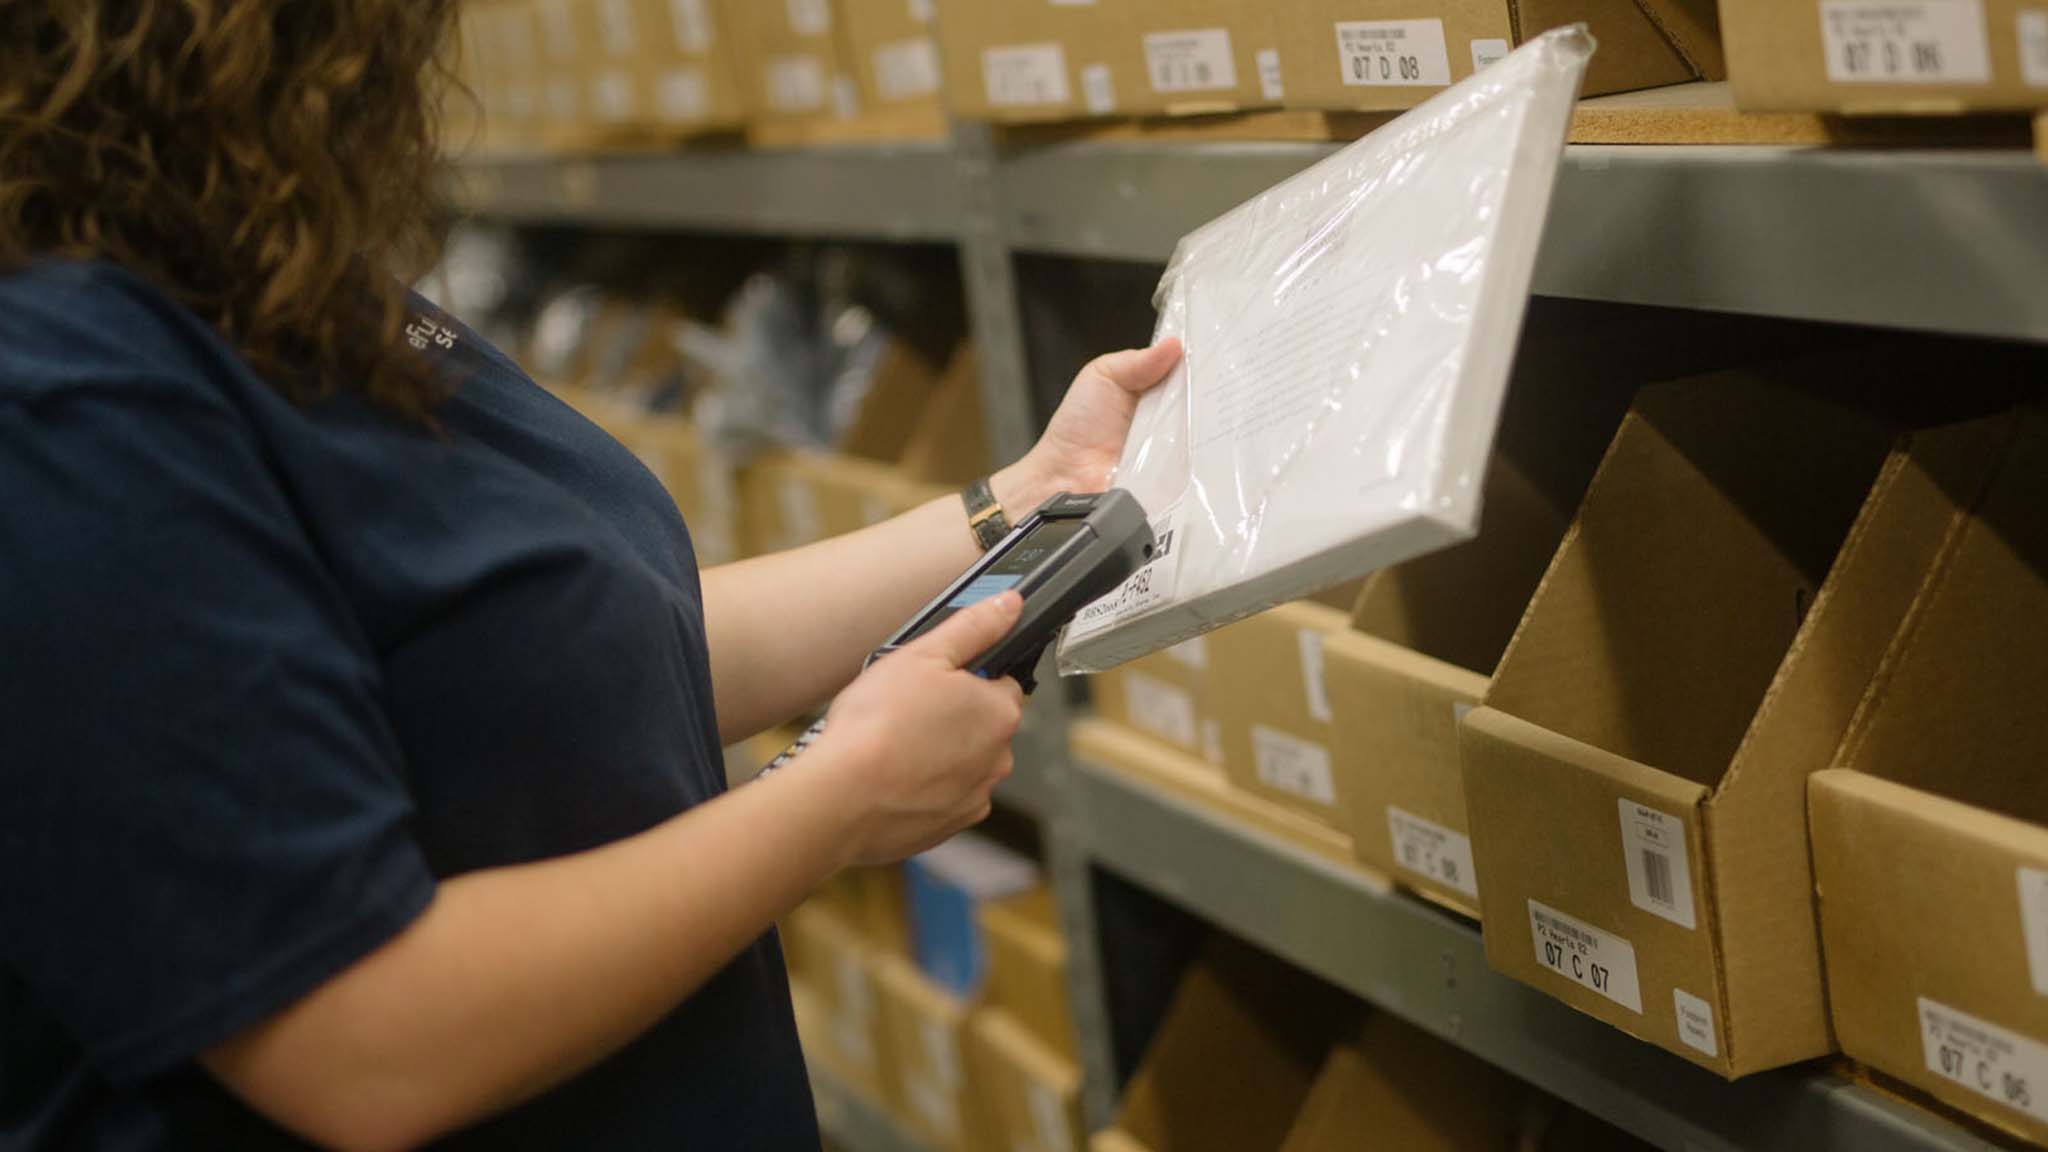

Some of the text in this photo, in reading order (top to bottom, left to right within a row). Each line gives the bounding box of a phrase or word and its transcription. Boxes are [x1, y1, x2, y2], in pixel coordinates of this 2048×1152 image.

[1353, 55, 1420, 80] 07 D 08
[1544, 941, 1609, 993] 07 C 07
[1940, 1044, 1963, 1077] 07
[1976, 1060, 1991, 1090] C
